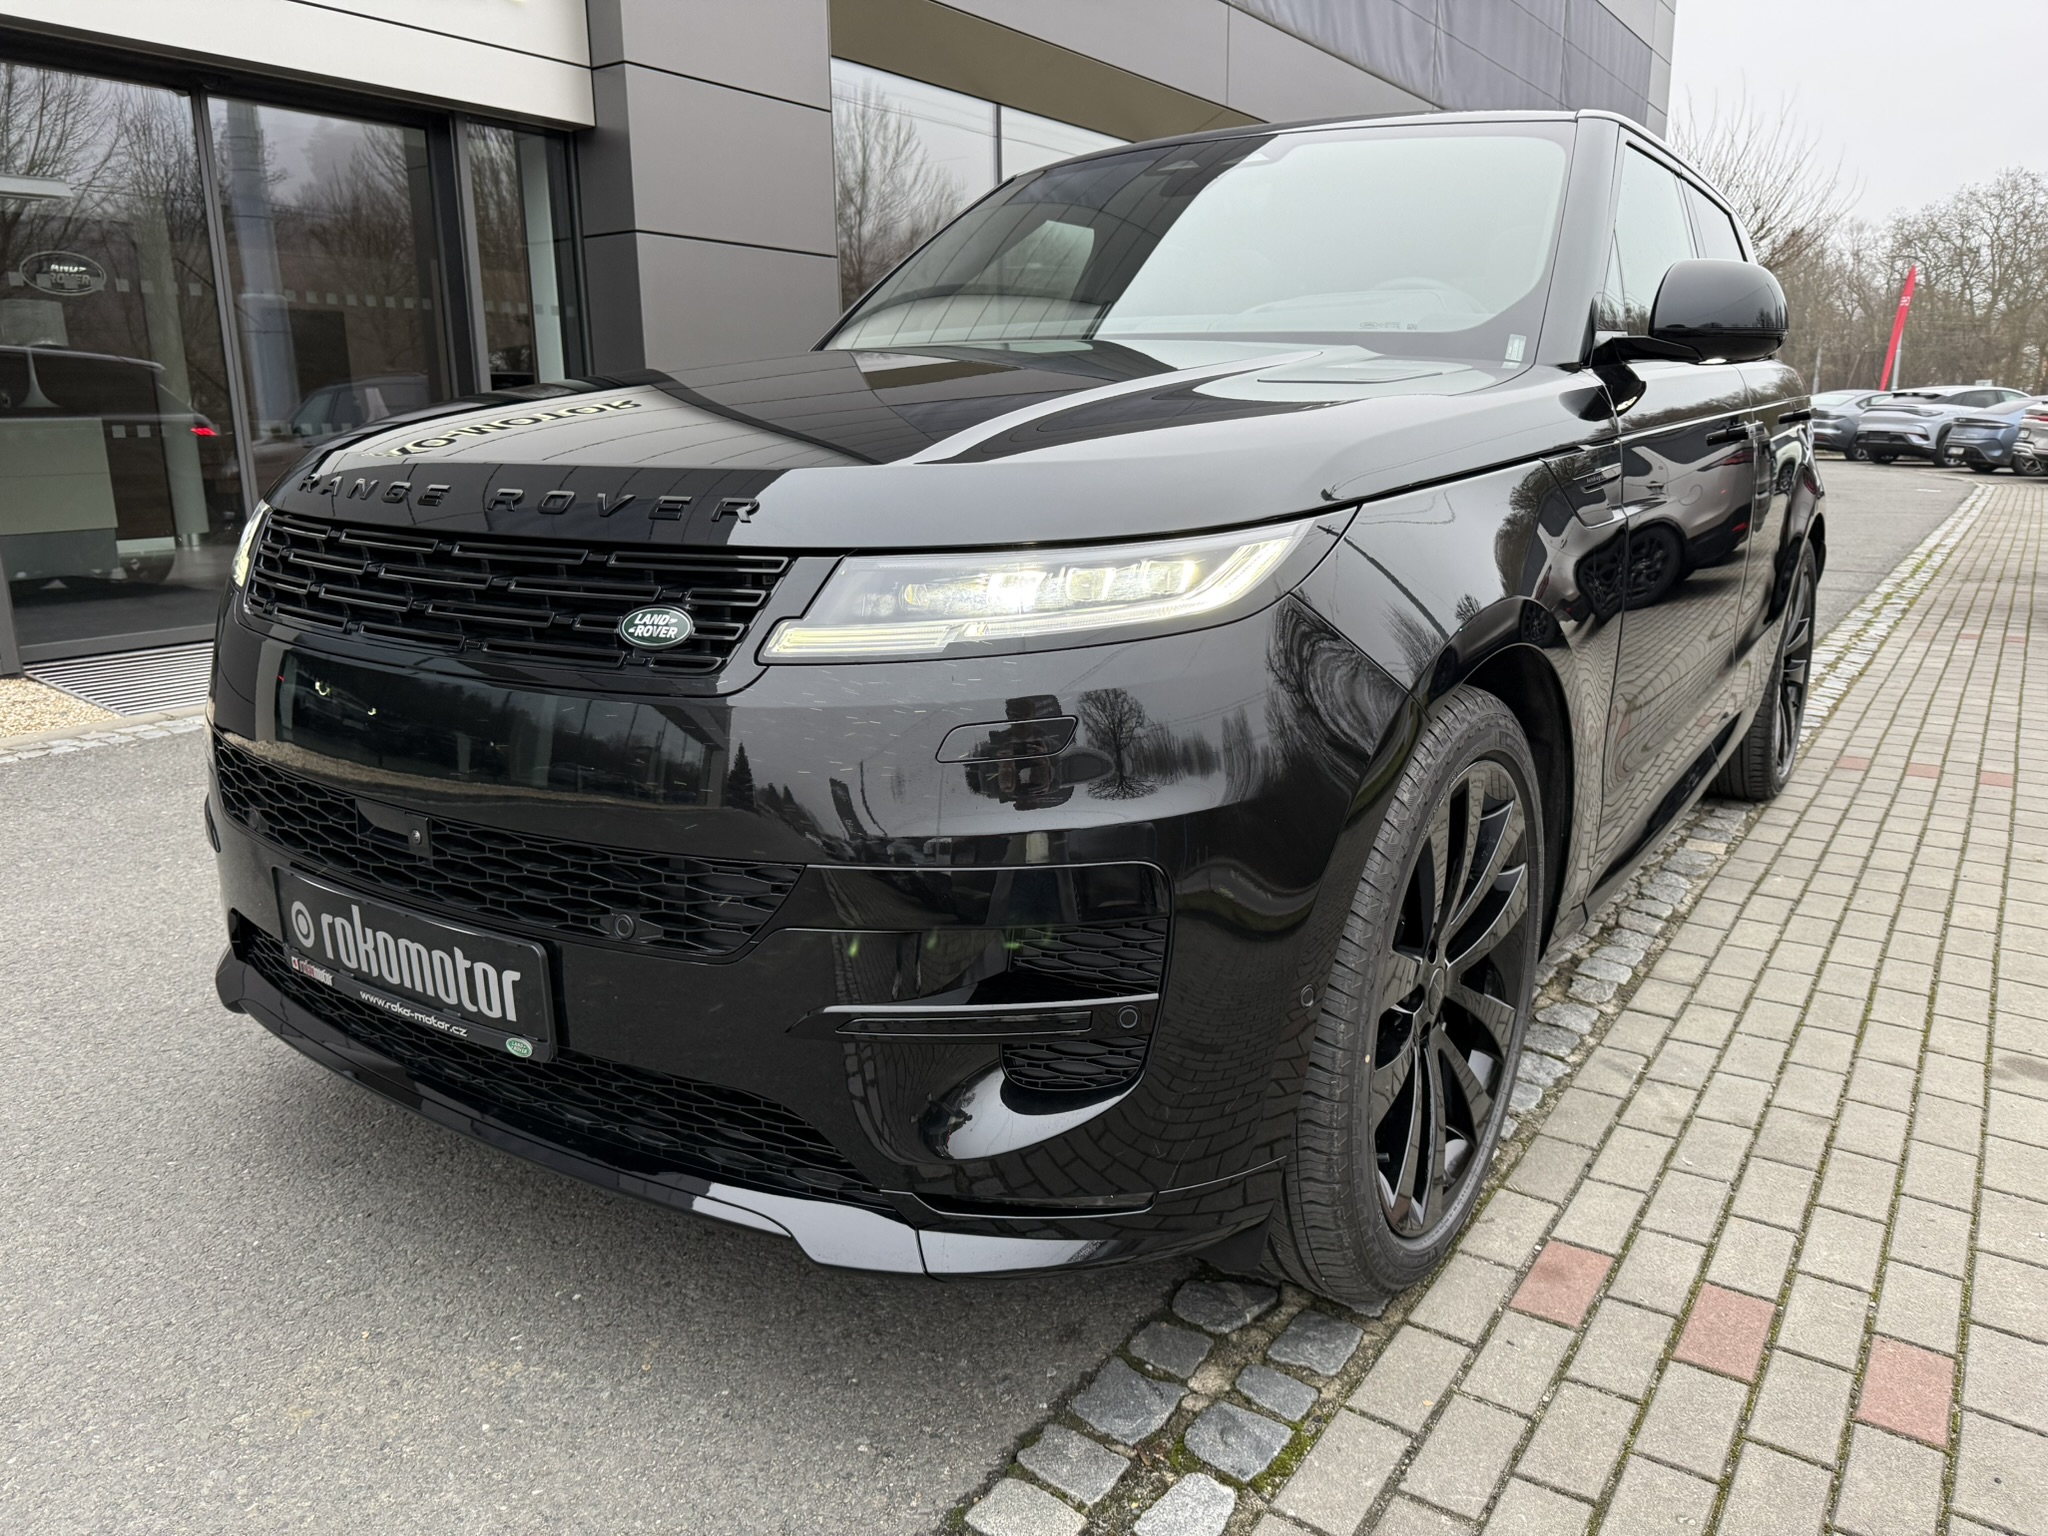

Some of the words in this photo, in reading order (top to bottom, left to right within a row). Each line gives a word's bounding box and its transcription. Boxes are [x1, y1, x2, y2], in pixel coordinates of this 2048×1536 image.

[298, 473, 452, 507] RANGE
[486, 487, 761, 524] ROVER
[633, 613, 671, 626] LAND
[633, 624, 679, 639] ROVER
[320, 904, 522, 1023] rokomotor
[359, 990, 469, 1038] www.roko-motor.cz
